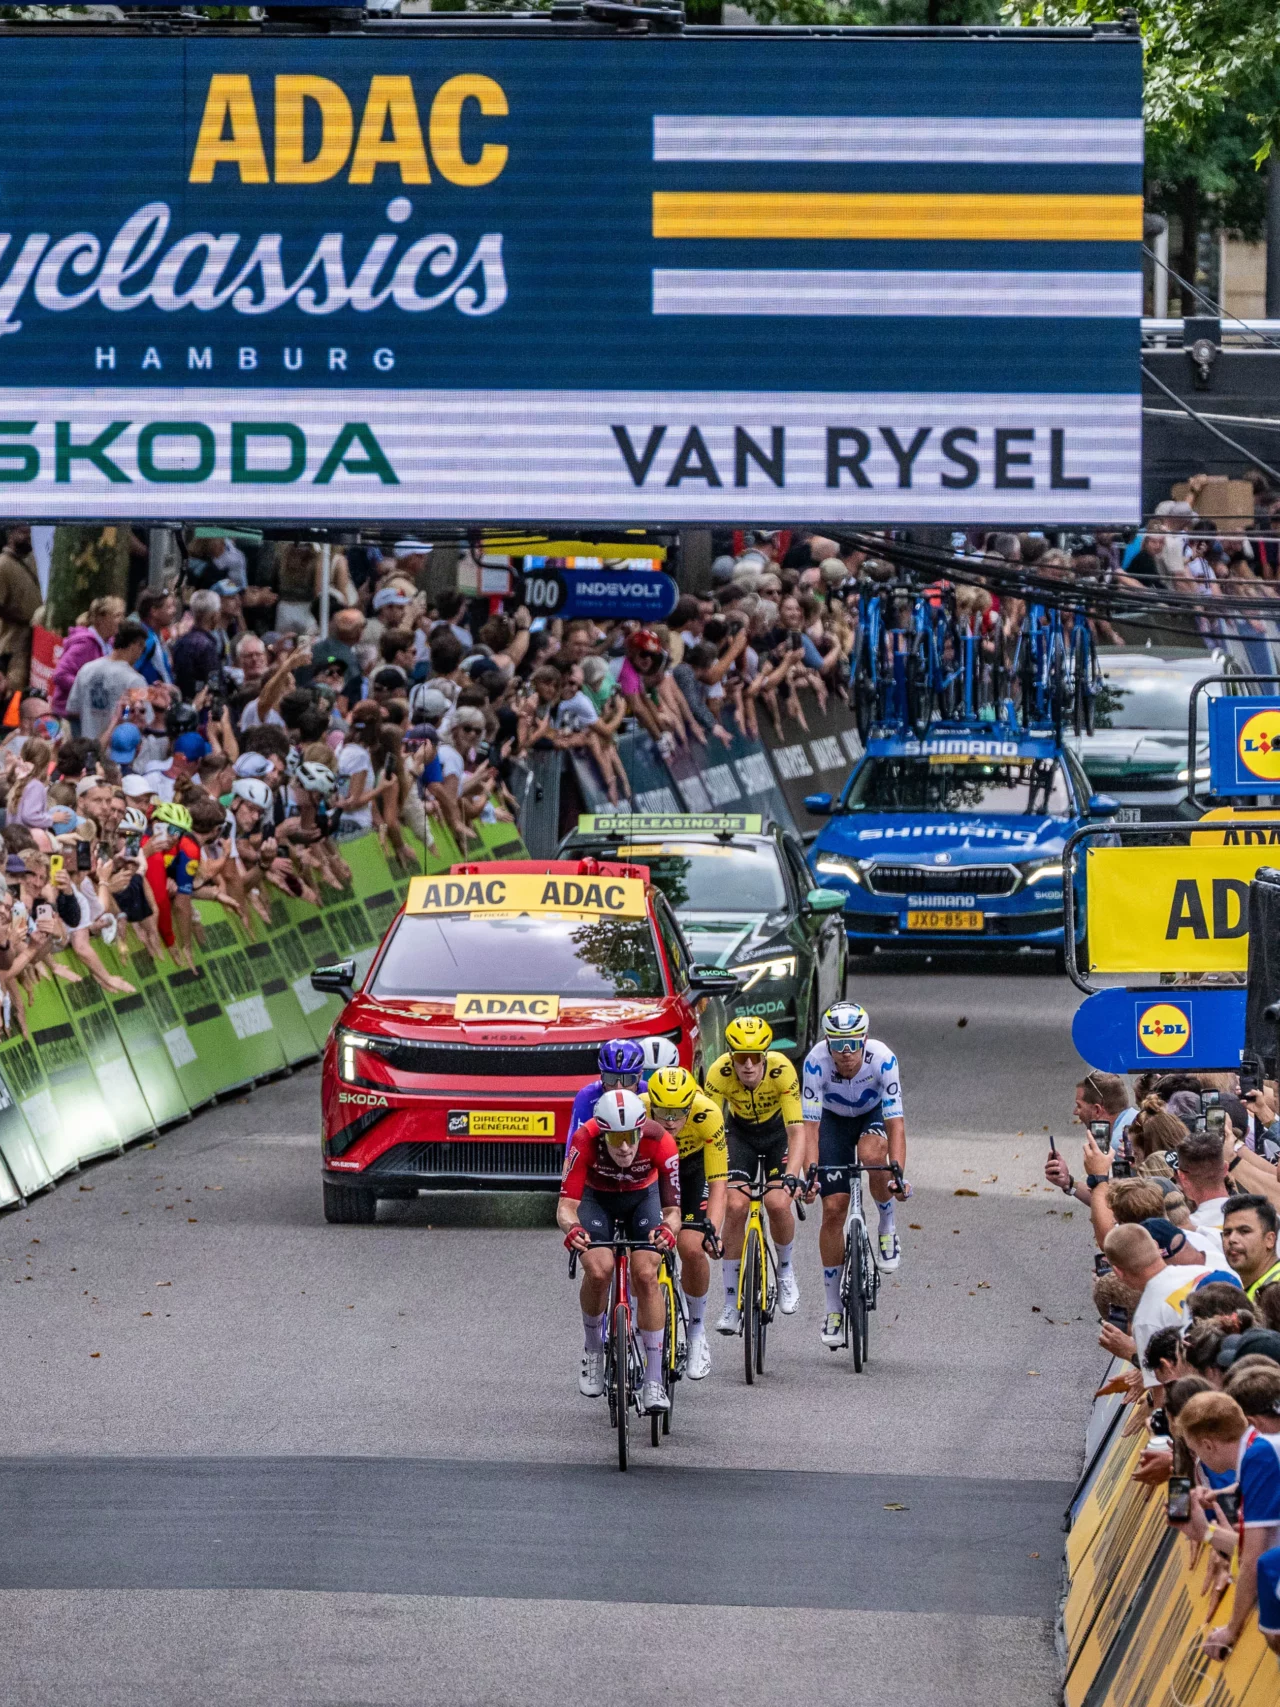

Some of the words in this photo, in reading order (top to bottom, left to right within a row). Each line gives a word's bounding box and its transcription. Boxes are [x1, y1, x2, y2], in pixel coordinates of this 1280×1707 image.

[188, 73, 509, 187] ADAC
[95, 346, 395, 371] HAMBURG
[611, 425, 785, 488] VAN
[826, 427, 1090, 490] RYSEL
[524, 578, 559, 608] 100
[575, 582, 663, 597] INDEVOLT
[905, 740, 1018, 756] SHIMANO
[858, 825, 1037, 843] SHIMANO
[422, 880, 506, 908] ADAC
[540, 881, 625, 909] ADAC
[464, 1000, 549, 1014] ADAC
[537, 1116, 548, 1131] 1
